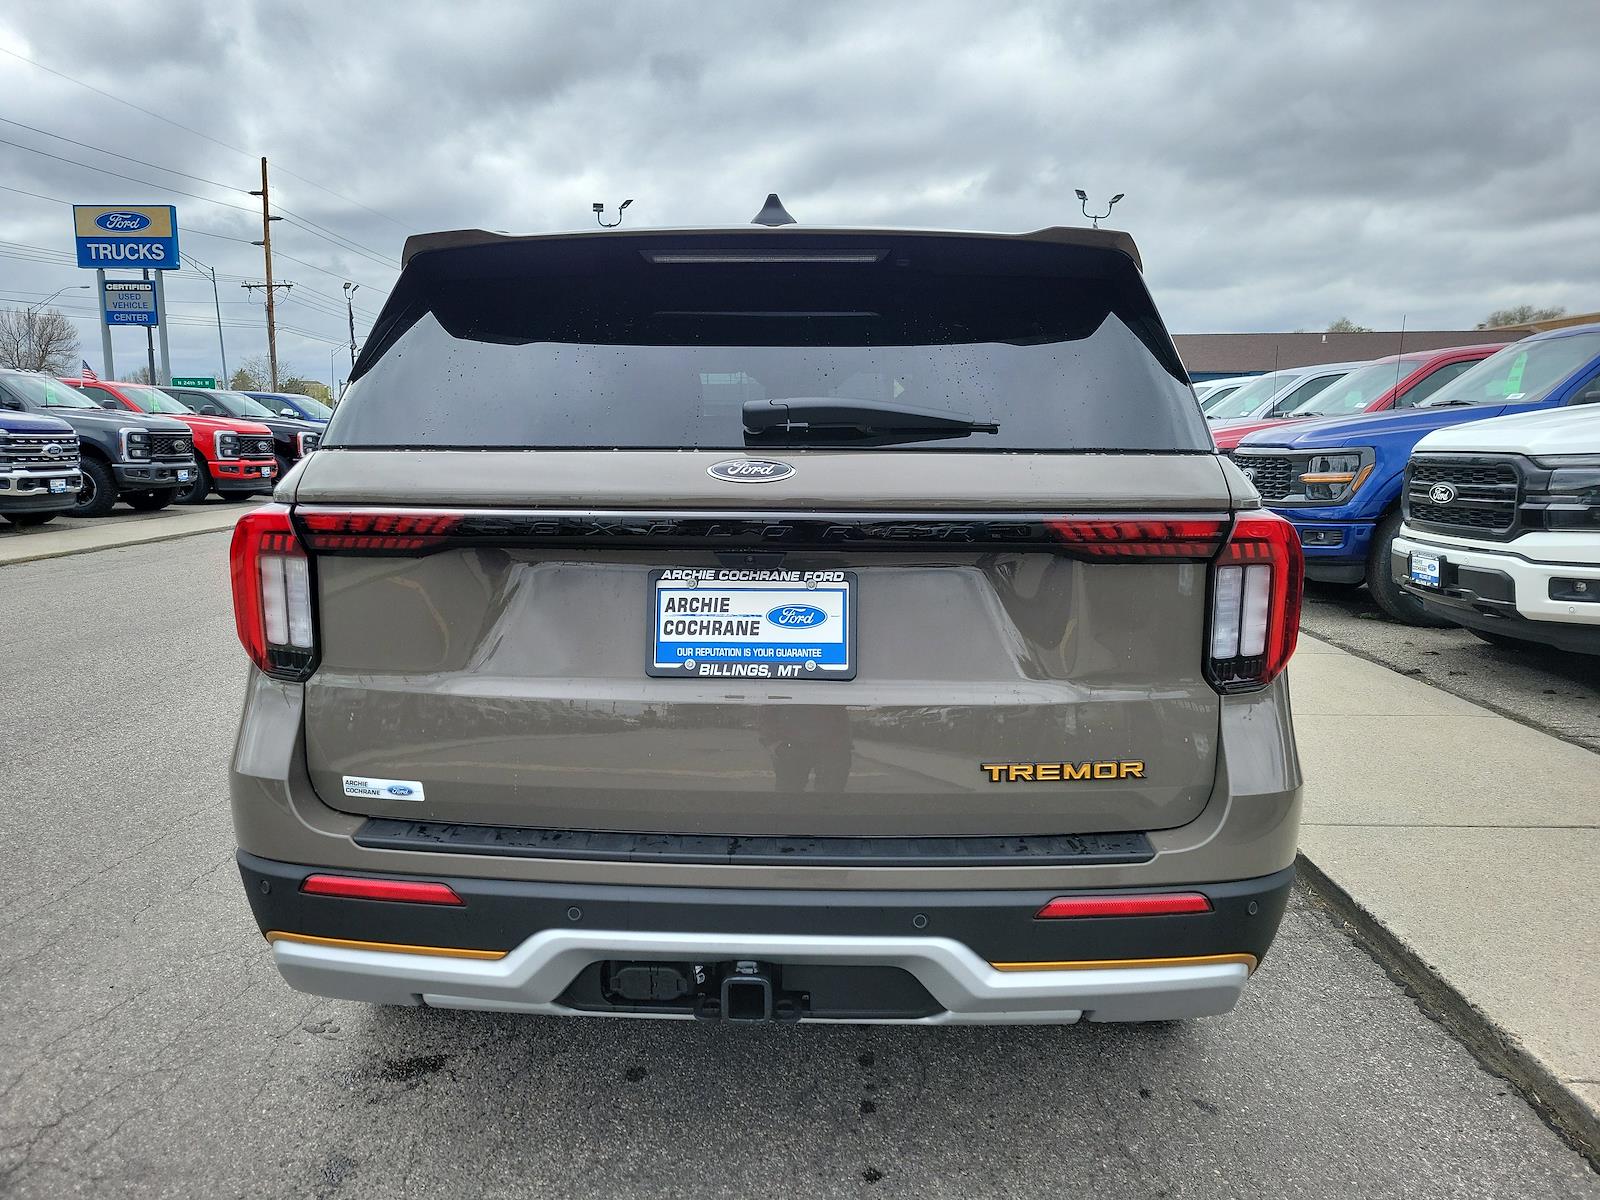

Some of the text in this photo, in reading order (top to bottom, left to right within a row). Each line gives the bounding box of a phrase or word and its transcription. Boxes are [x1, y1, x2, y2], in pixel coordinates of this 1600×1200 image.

[106, 213, 140, 229] Ford
[86, 243, 165, 260] TRUCKS
[112, 301, 149, 309] VEHICLE
[113, 313, 149, 321] CENTER
[727, 460, 775, 475] Ford
[1433, 487, 1450, 501] Ford
[528, 522, 976, 542] EXPLORER
[661, 569, 845, 582] ARCHIE COCHRANE FORD
[664, 597, 731, 613] ARCHIE
[778, 608, 815, 625] Ford
[663, 620, 761, 636] COCHRANE
[676, 647, 822, 658] OUR REPUTATION IS YOUR GUARANTEE
[698, 663, 803, 678] BILLINGS, MT
[980, 760, 1147, 782] TREMOR
[345, 787, 380, 796] COCHRANE
